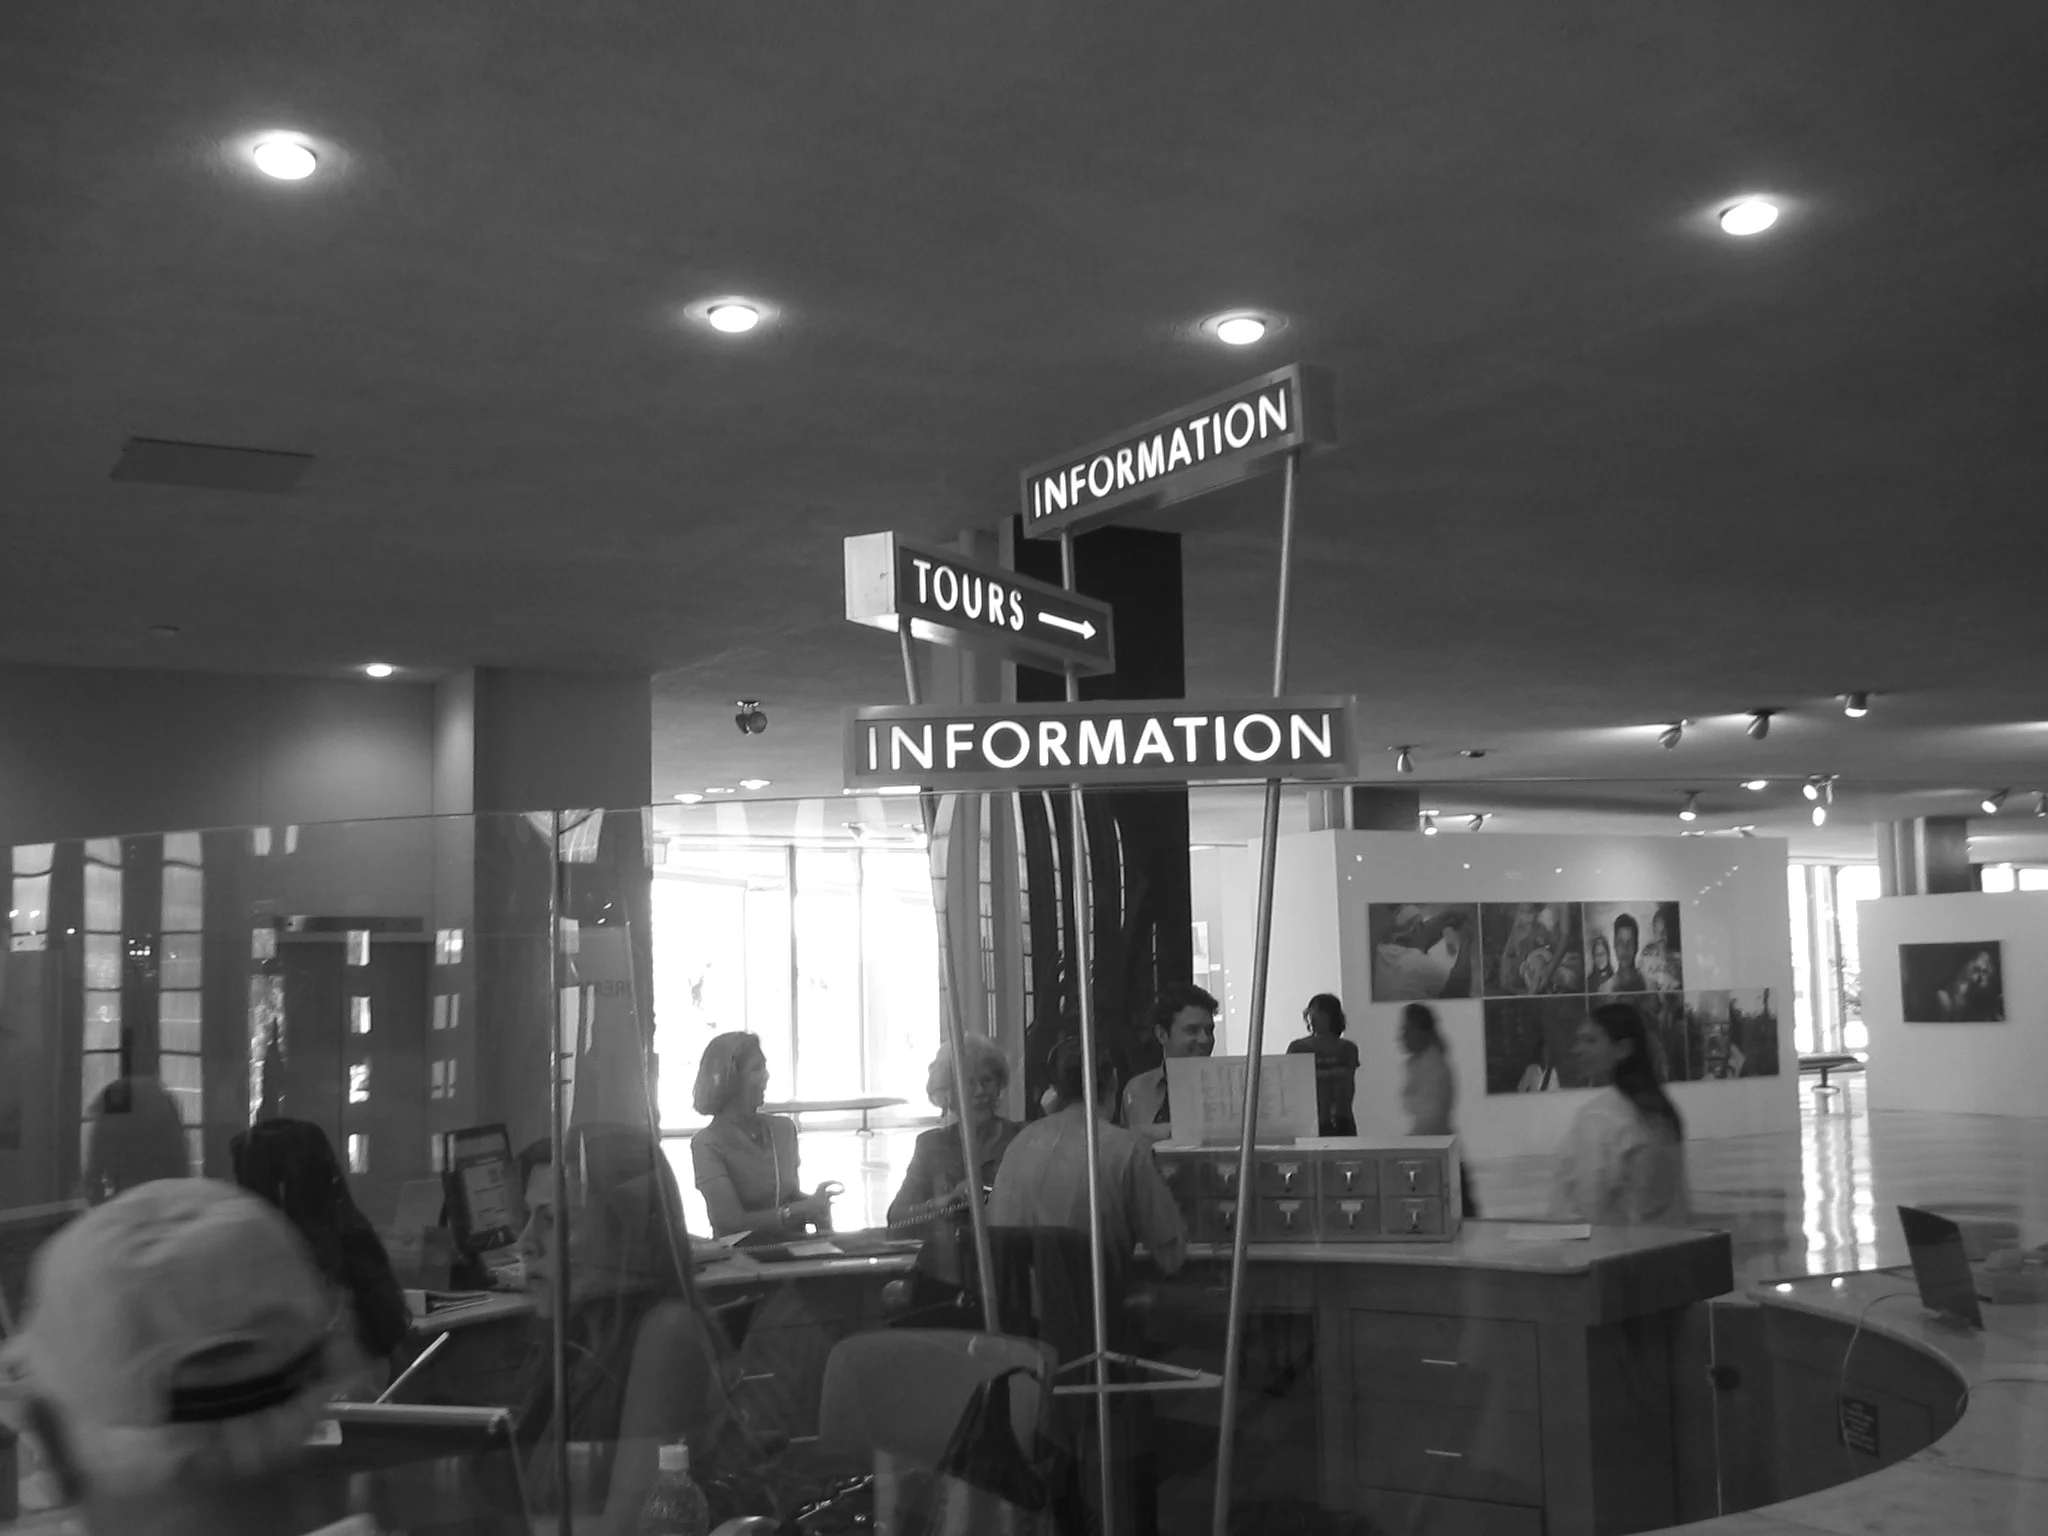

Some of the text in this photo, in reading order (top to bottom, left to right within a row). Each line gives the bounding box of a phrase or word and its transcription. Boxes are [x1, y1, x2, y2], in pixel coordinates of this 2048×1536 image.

[1033, 387, 1288, 519] INFORMATION
[912, 558, 1025, 632] TOURS
[867, 713, 1333, 771] INFORMATION
